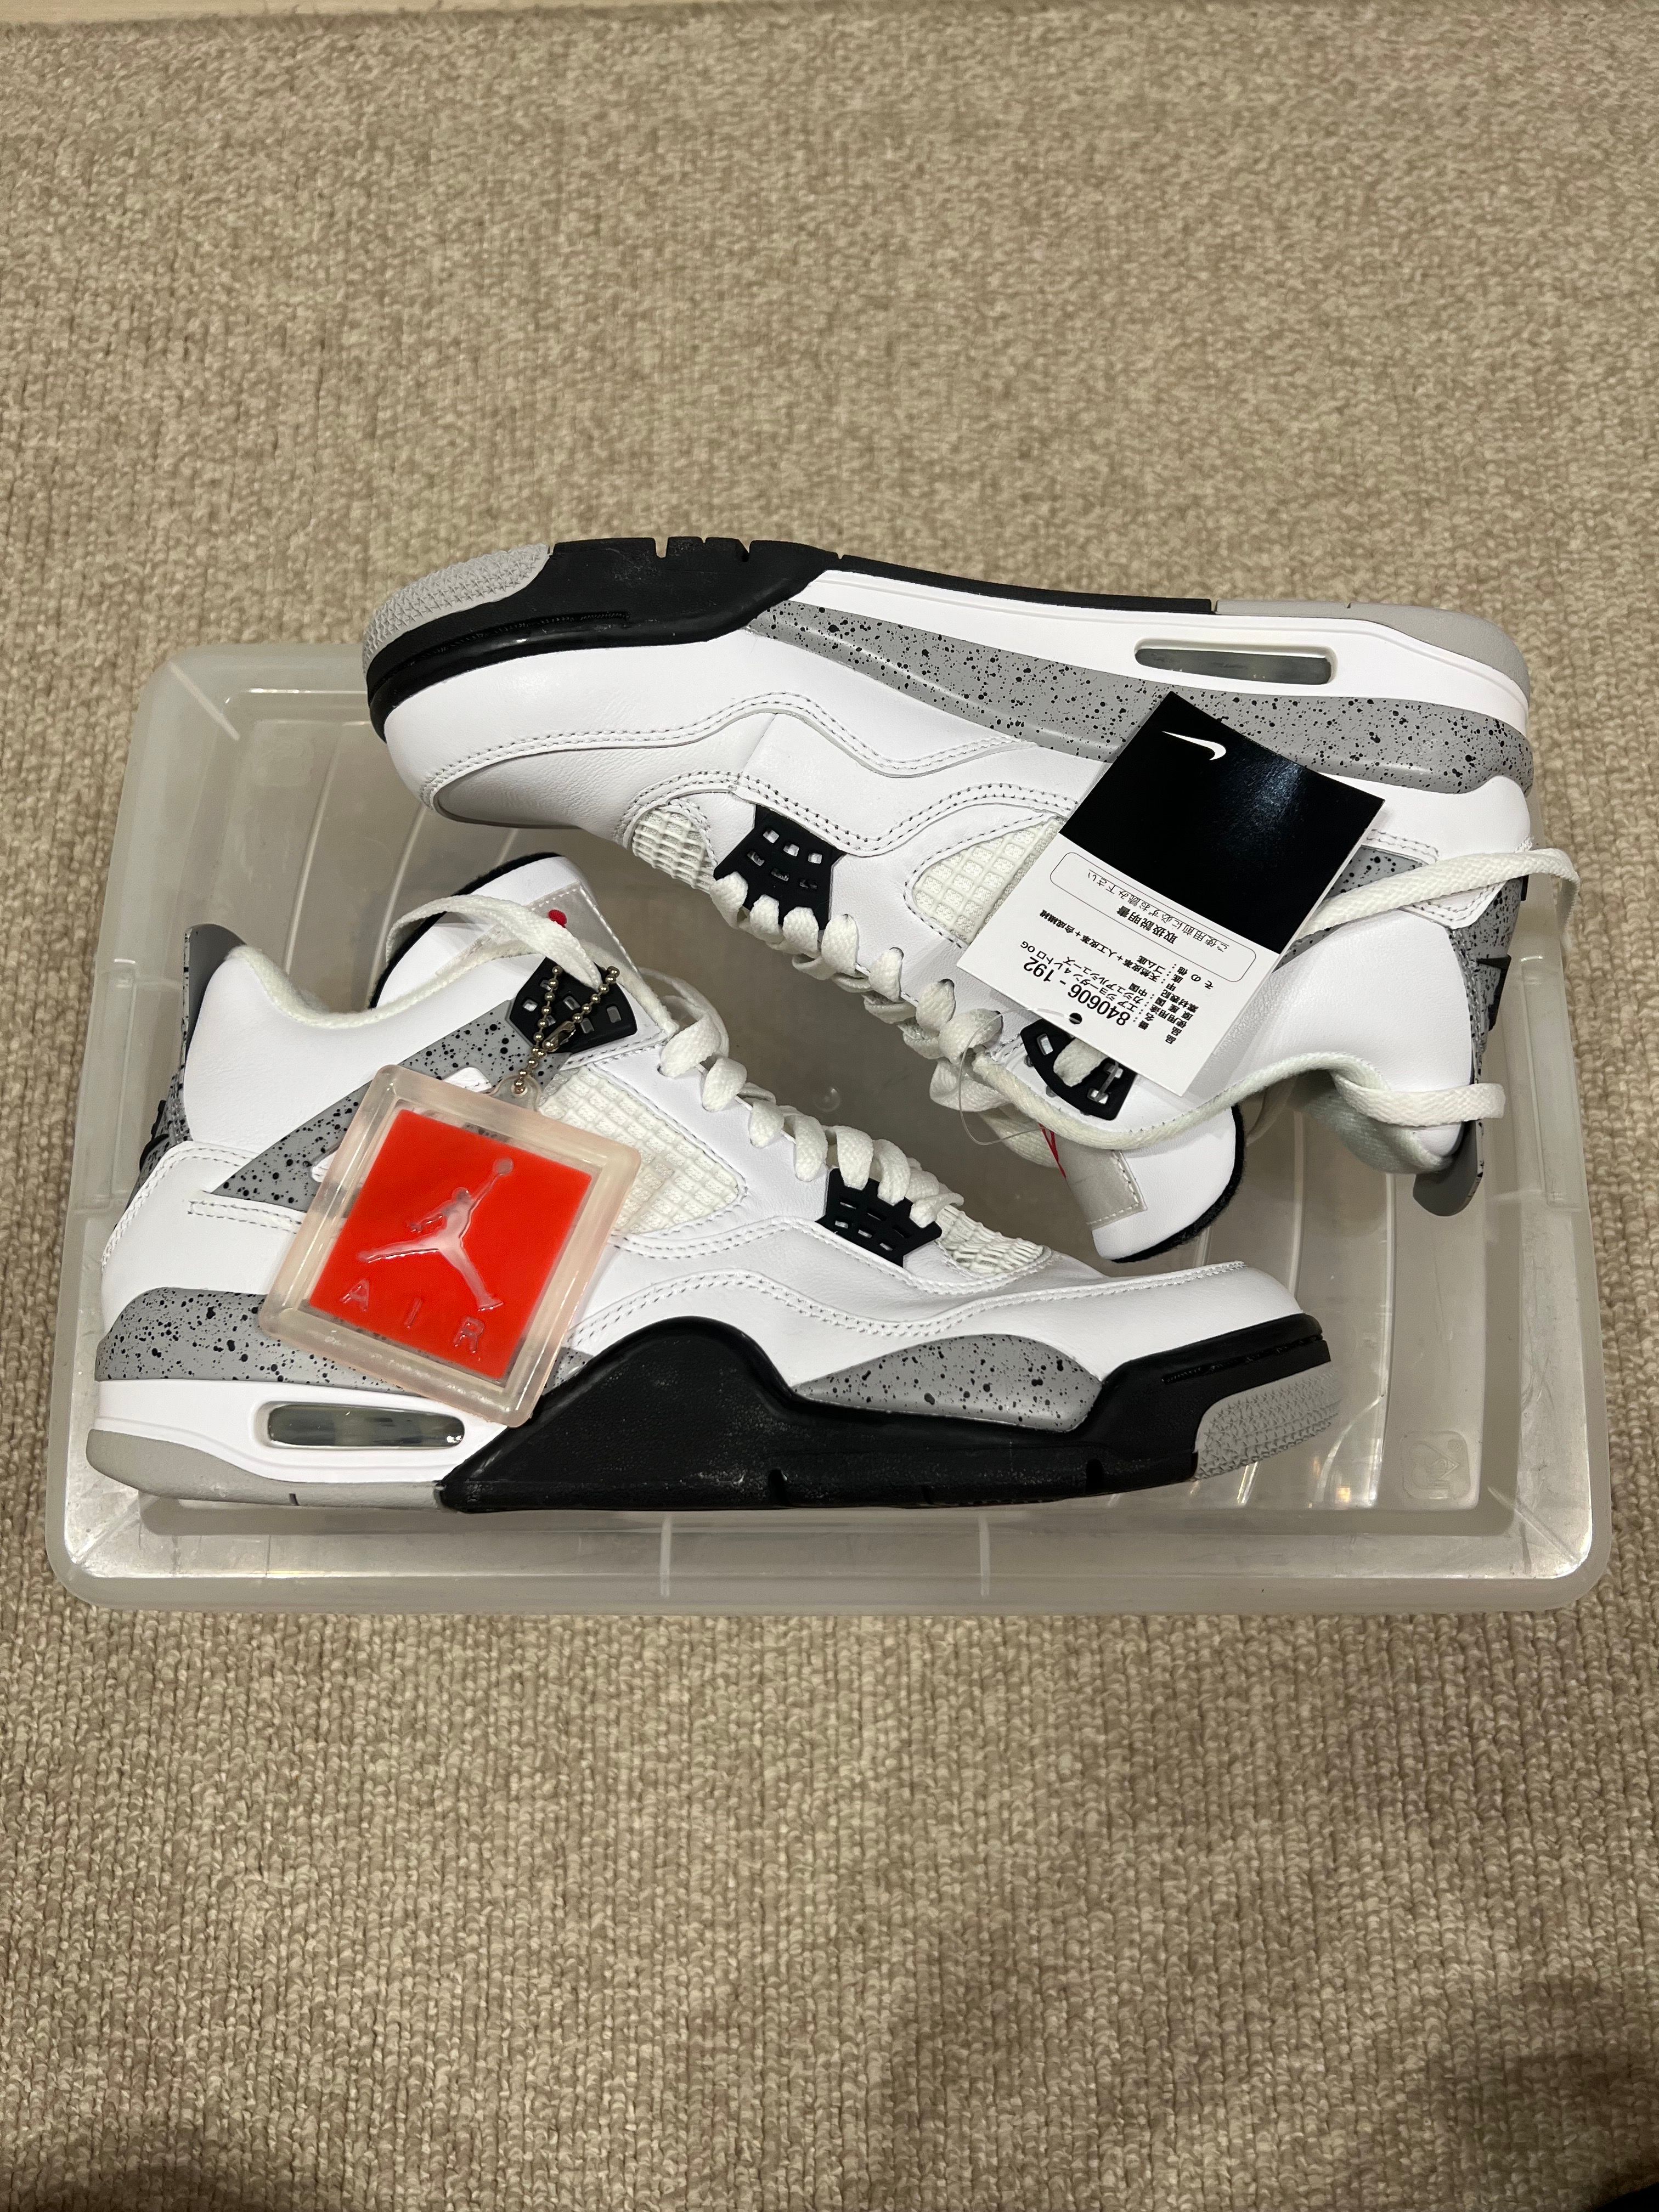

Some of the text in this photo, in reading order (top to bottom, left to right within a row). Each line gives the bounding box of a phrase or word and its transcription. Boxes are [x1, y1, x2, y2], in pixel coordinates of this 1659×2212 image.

[1088, 870, 1229, 952] ご使用前に必ずお読み下さい
[1116, 905, 1178, 944] 取扱説明書
[1020, 941, 1035, 953] OG
[1036, 950, 1063, 970] レトロ
[1023, 956, 1054, 982] 192
[1073, 974, 1118, 1001] ジョーダン
[1068, 984, 1131, 1026] 840606
[1117, 1001, 1138, 1013] エア
[1160, 989, 1199, 1013] 素材表記
